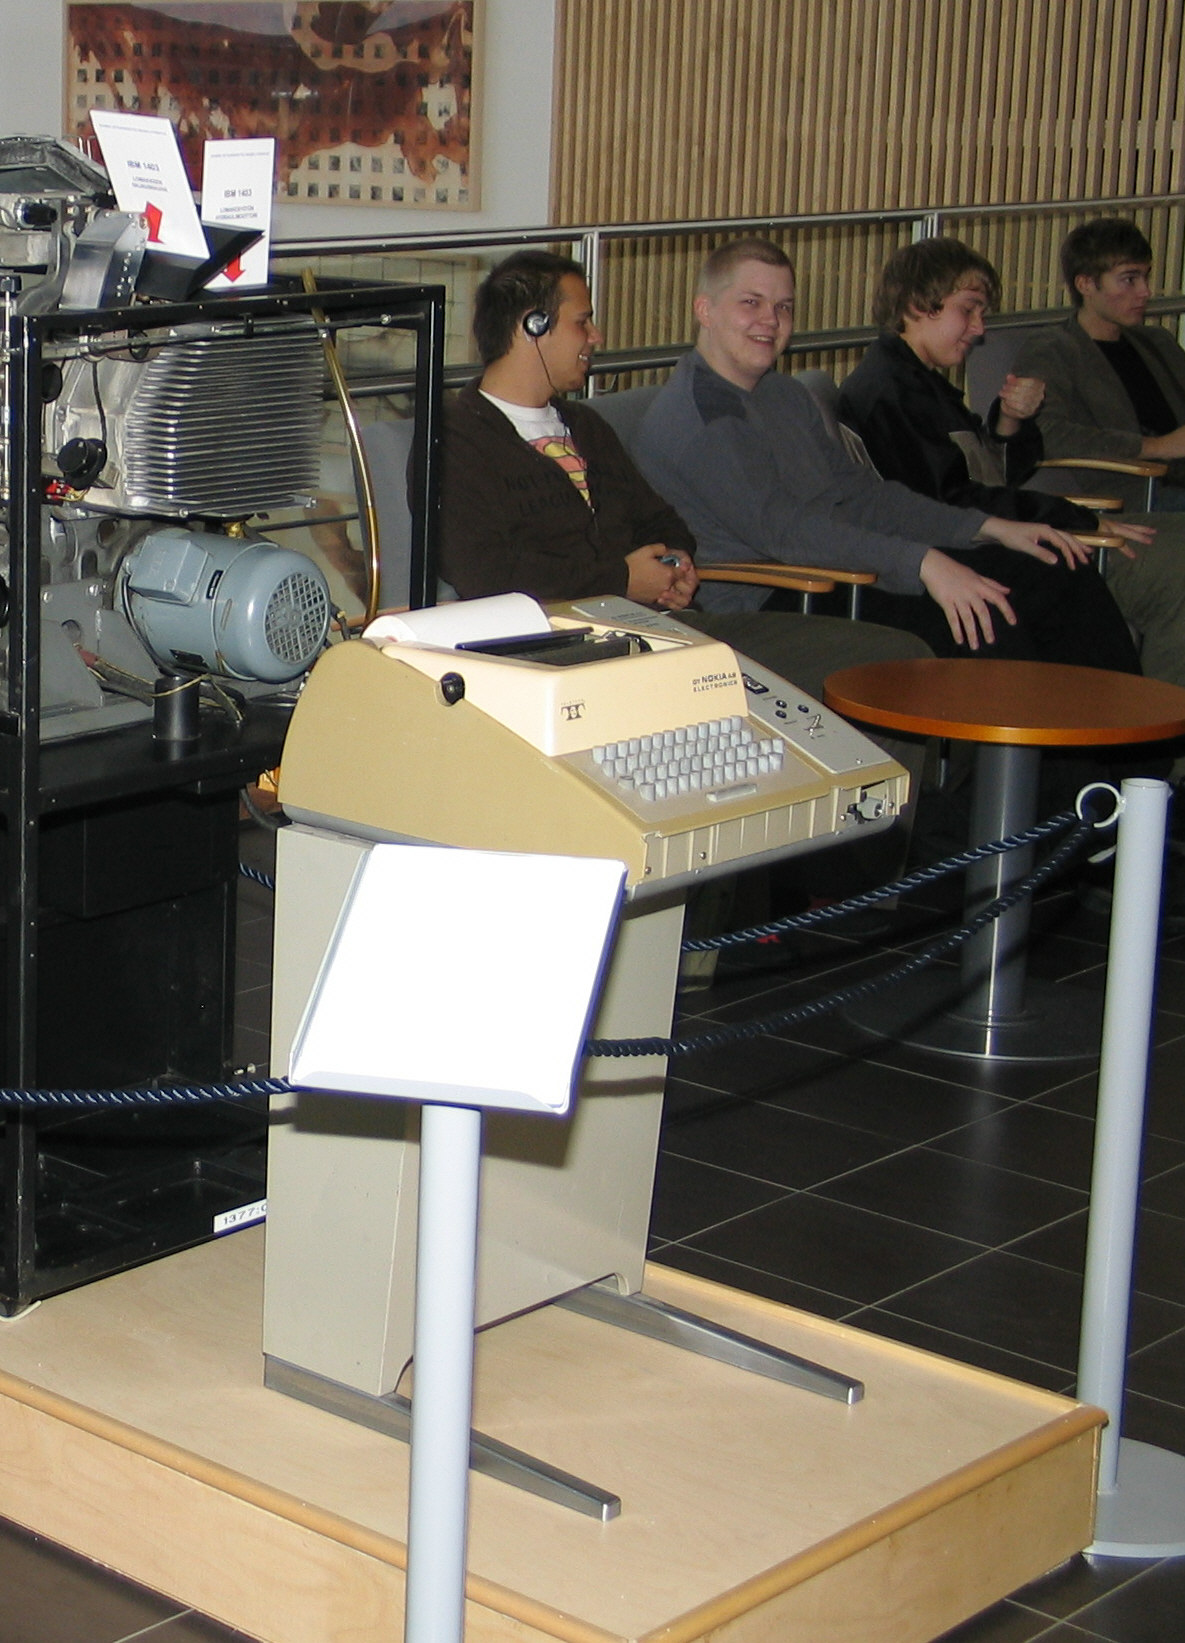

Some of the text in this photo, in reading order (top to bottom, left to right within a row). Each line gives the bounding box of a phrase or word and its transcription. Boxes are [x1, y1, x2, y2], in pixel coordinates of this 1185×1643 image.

[127, 160, 141, 168] IBM
[224, 189, 236, 198] IBM
[702, 672, 727, 683] NOKIA
